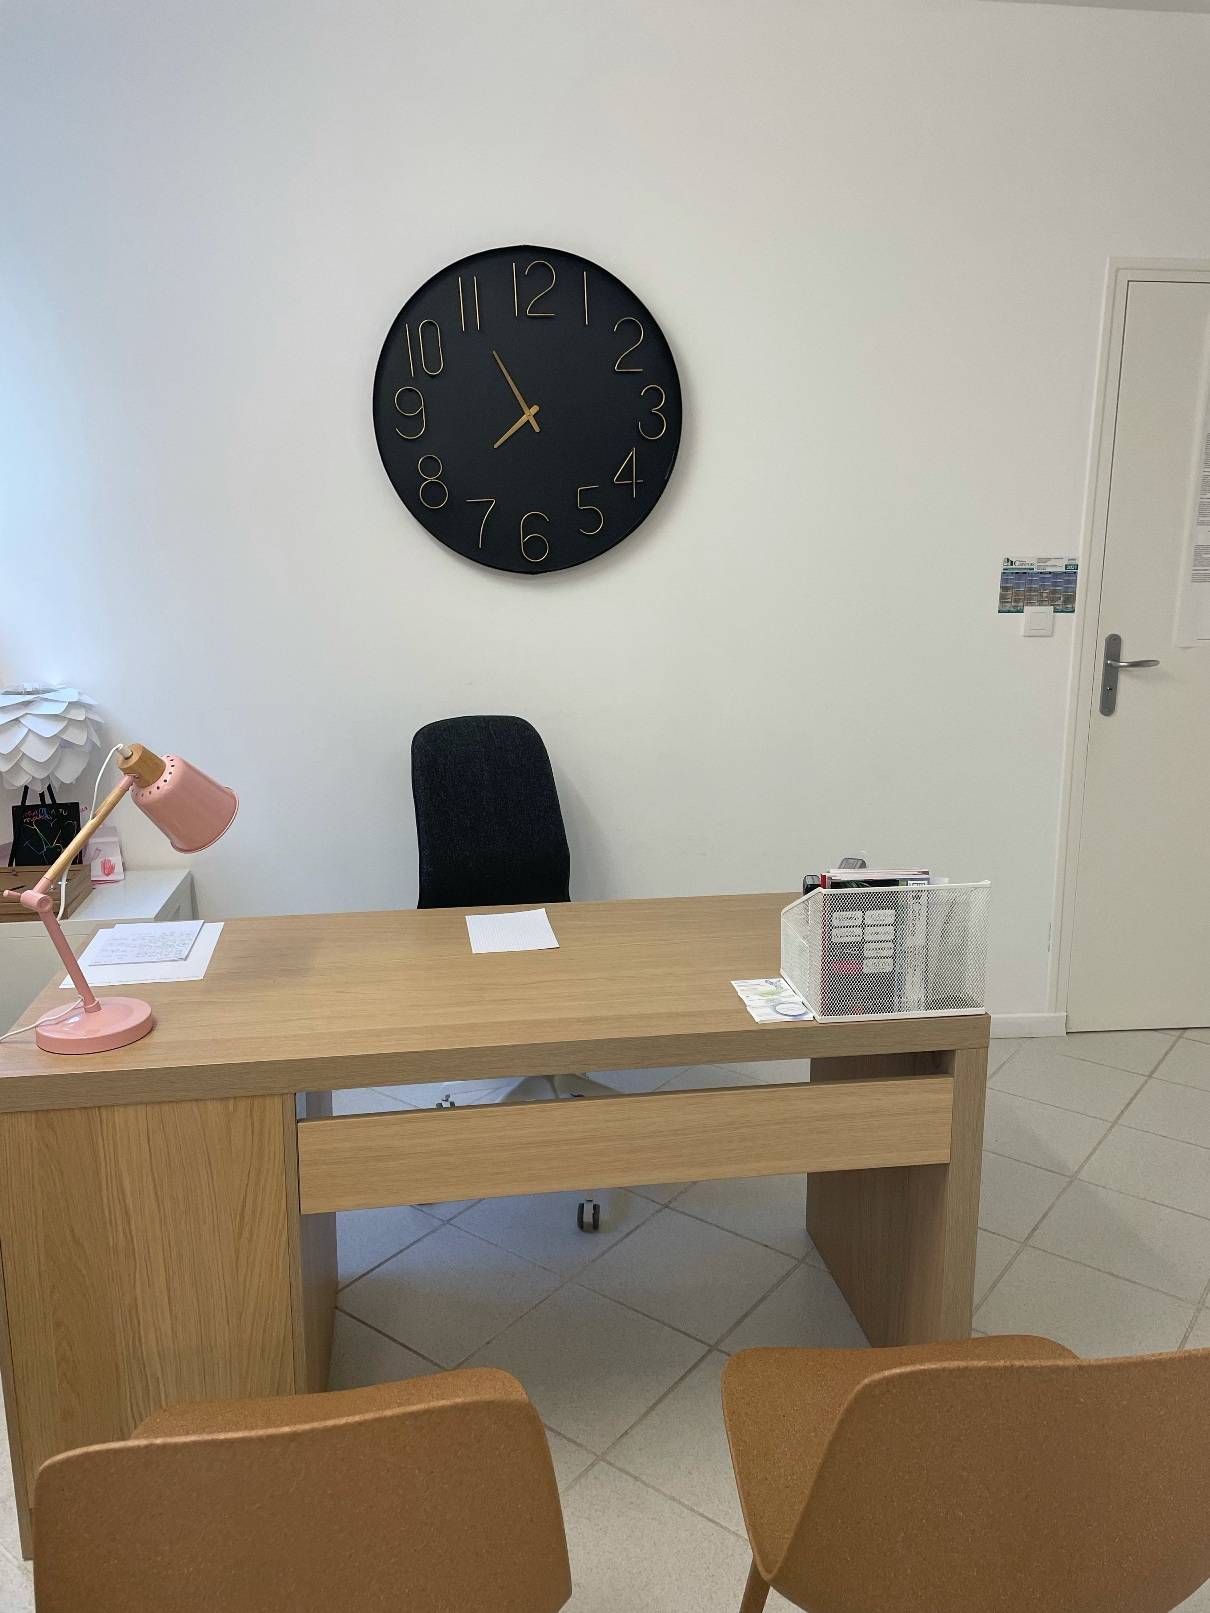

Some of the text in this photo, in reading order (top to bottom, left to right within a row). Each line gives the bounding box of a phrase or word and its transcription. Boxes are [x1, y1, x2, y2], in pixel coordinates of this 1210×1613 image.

[457, 276, 480, 331] 11
[512, 261, 555, 316] 12
[405, 320, 444, 376] 10
[613, 317, 643, 371] 2
[395, 386, 425, 439] 9
[639, 385, 667, 439] 3
[417, 454, 448, 508] 8
[614, 447, 643, 498] 4
[466, 499, 495, 549] 7
[521, 511, 549, 562] 6
[577, 485, 604, 535] 5
